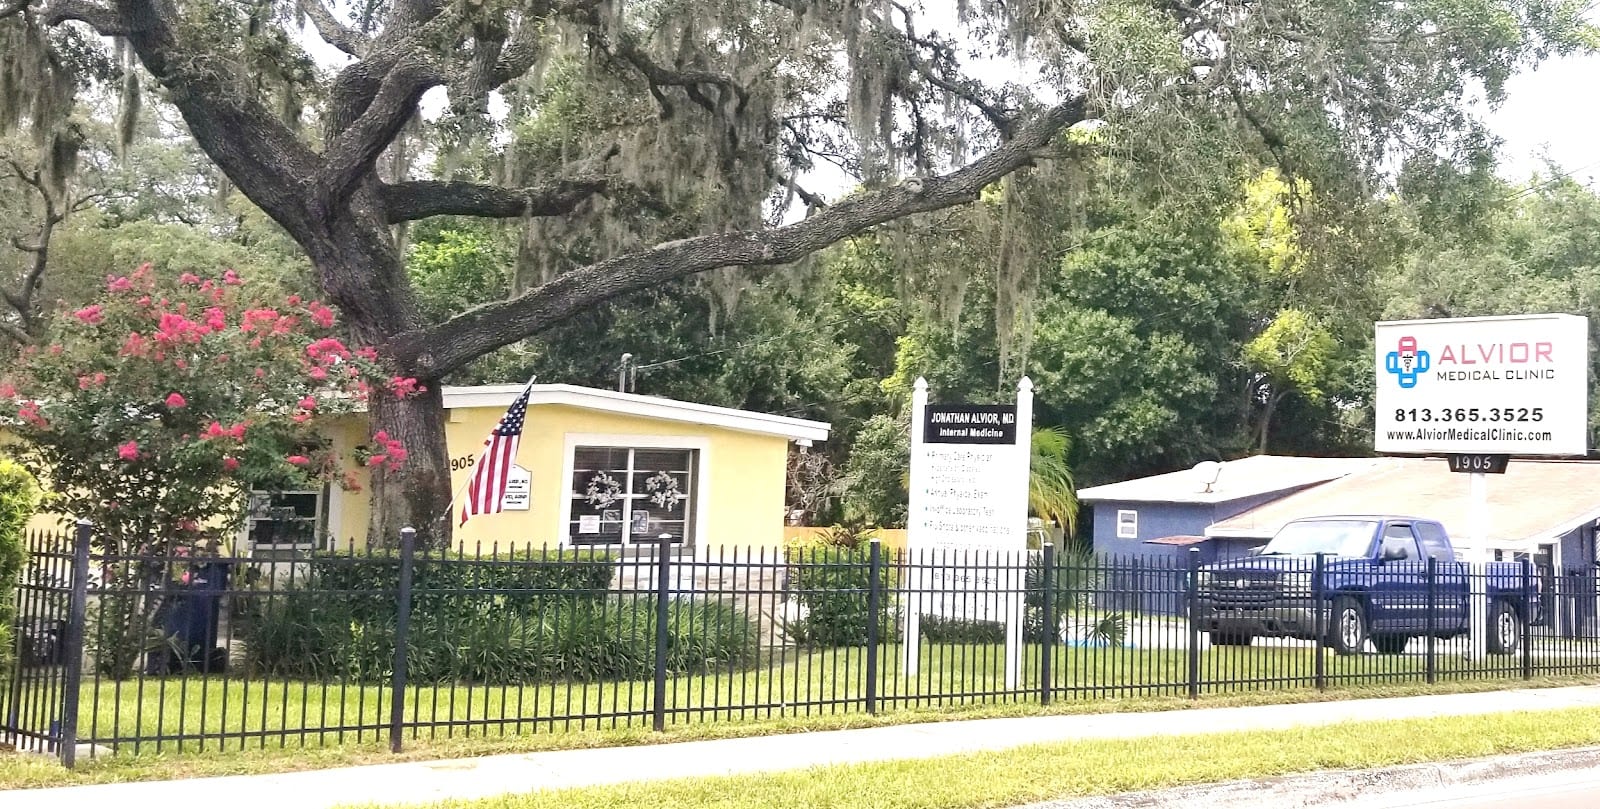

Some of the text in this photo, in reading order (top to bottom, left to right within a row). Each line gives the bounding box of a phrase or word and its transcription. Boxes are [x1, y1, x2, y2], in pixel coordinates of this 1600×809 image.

[1438, 342, 1554, 365] ALVIOR
[1437, 369, 1555, 381] MEDICAL CLINIC
[931, 412, 970, 423] JONATHAN
[971, 413, 1000, 425] ALVIOR,
[1395, 408, 1544, 422] 813.365.3525
[939, 427, 1003, 438] Internal Medicine
[1387, 428, 1552, 442] www.AlviorMedicalClinic.com
[1455, 456, 1492, 470] 1905
